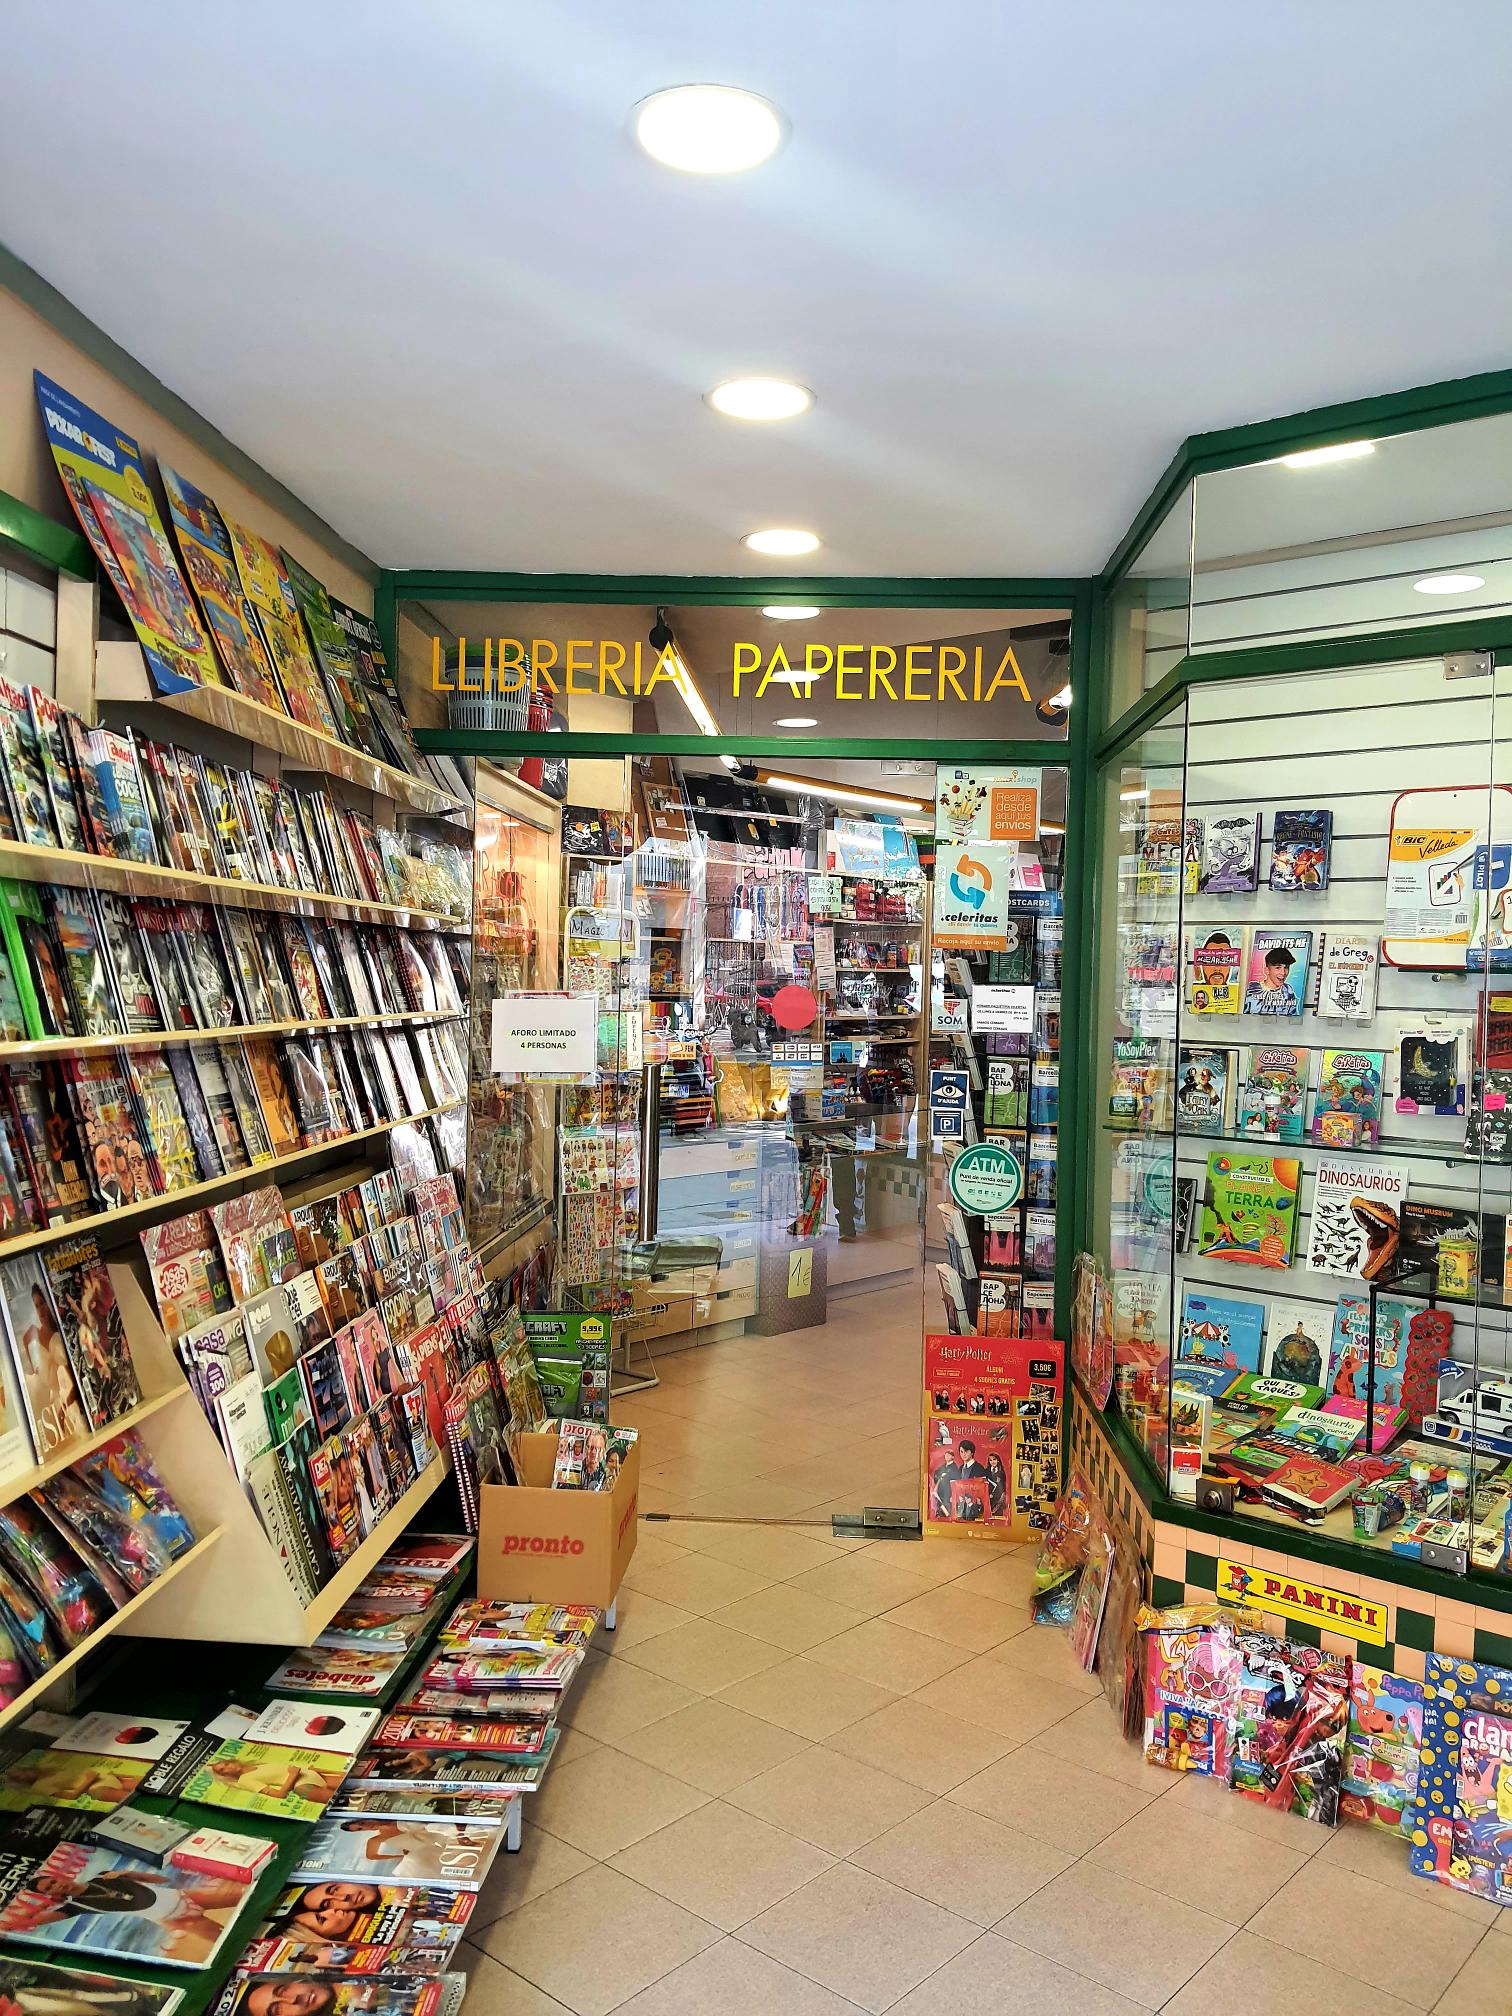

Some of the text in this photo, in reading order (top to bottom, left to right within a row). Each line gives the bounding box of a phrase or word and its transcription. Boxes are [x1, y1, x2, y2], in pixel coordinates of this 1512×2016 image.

[432, 636, 1032, 702] LLIBRERIA PAPERERIA
[996, 793, 1032, 802] Realiza
[996, 801, 1032, 811] desde
[1017, 812, 1031, 820] tus
[1419, 838, 1458, 858] Velleda
[1477, 864, 1485, 888] PILOT
[1008, 899, 1050, 907] OSTCARDS
[938, 938, 959, 946] Recoja
[1258, 939, 1280, 950] DAVID
[1329, 947, 1368, 961] de Greg
[937, 1016, 963, 1025] SOM
[511, 1028, 577, 1037] AFORO LIMITADO
[520, 1042, 567, 1050] 4 PERSONAS
[1117, 1042, 1157, 1057] YoSoyPlex
[990, 1066, 1006, 1074] BAR
[943, 1119, 951, 1129] P
[968, 1157, 1006, 1174] ATM
[980, 1175, 996, 1183] venda
[1319, 1169, 1401, 1192] DINOSAURIOS
[1226, 1181, 1275, 1195] PLANETA
[1226, 1191, 1274, 1208] TERRA
[1405, 1204, 1453, 1218] DINO MUSEUM
[213, 1282, 228, 1299] CHO
[526, 1322, 567, 1333] CRAFT
[1354, 1334, 1383, 1349] SOS
[940, 1346, 992, 1361] Harry Potter
[210, 1378, 225, 1395] 300
[1256, 1385, 1301, 1398] TAQUES?
[1284, 1383, 1298, 1391] TE
[502, 1535, 585, 1555] pronto
[1264, 1577, 1379, 1627] PANINI
[284, 1668, 376, 1684] diabetes
[1383, 1674, 1412, 1698] Peppa
[1432, 1822, 1453, 1839] EM
